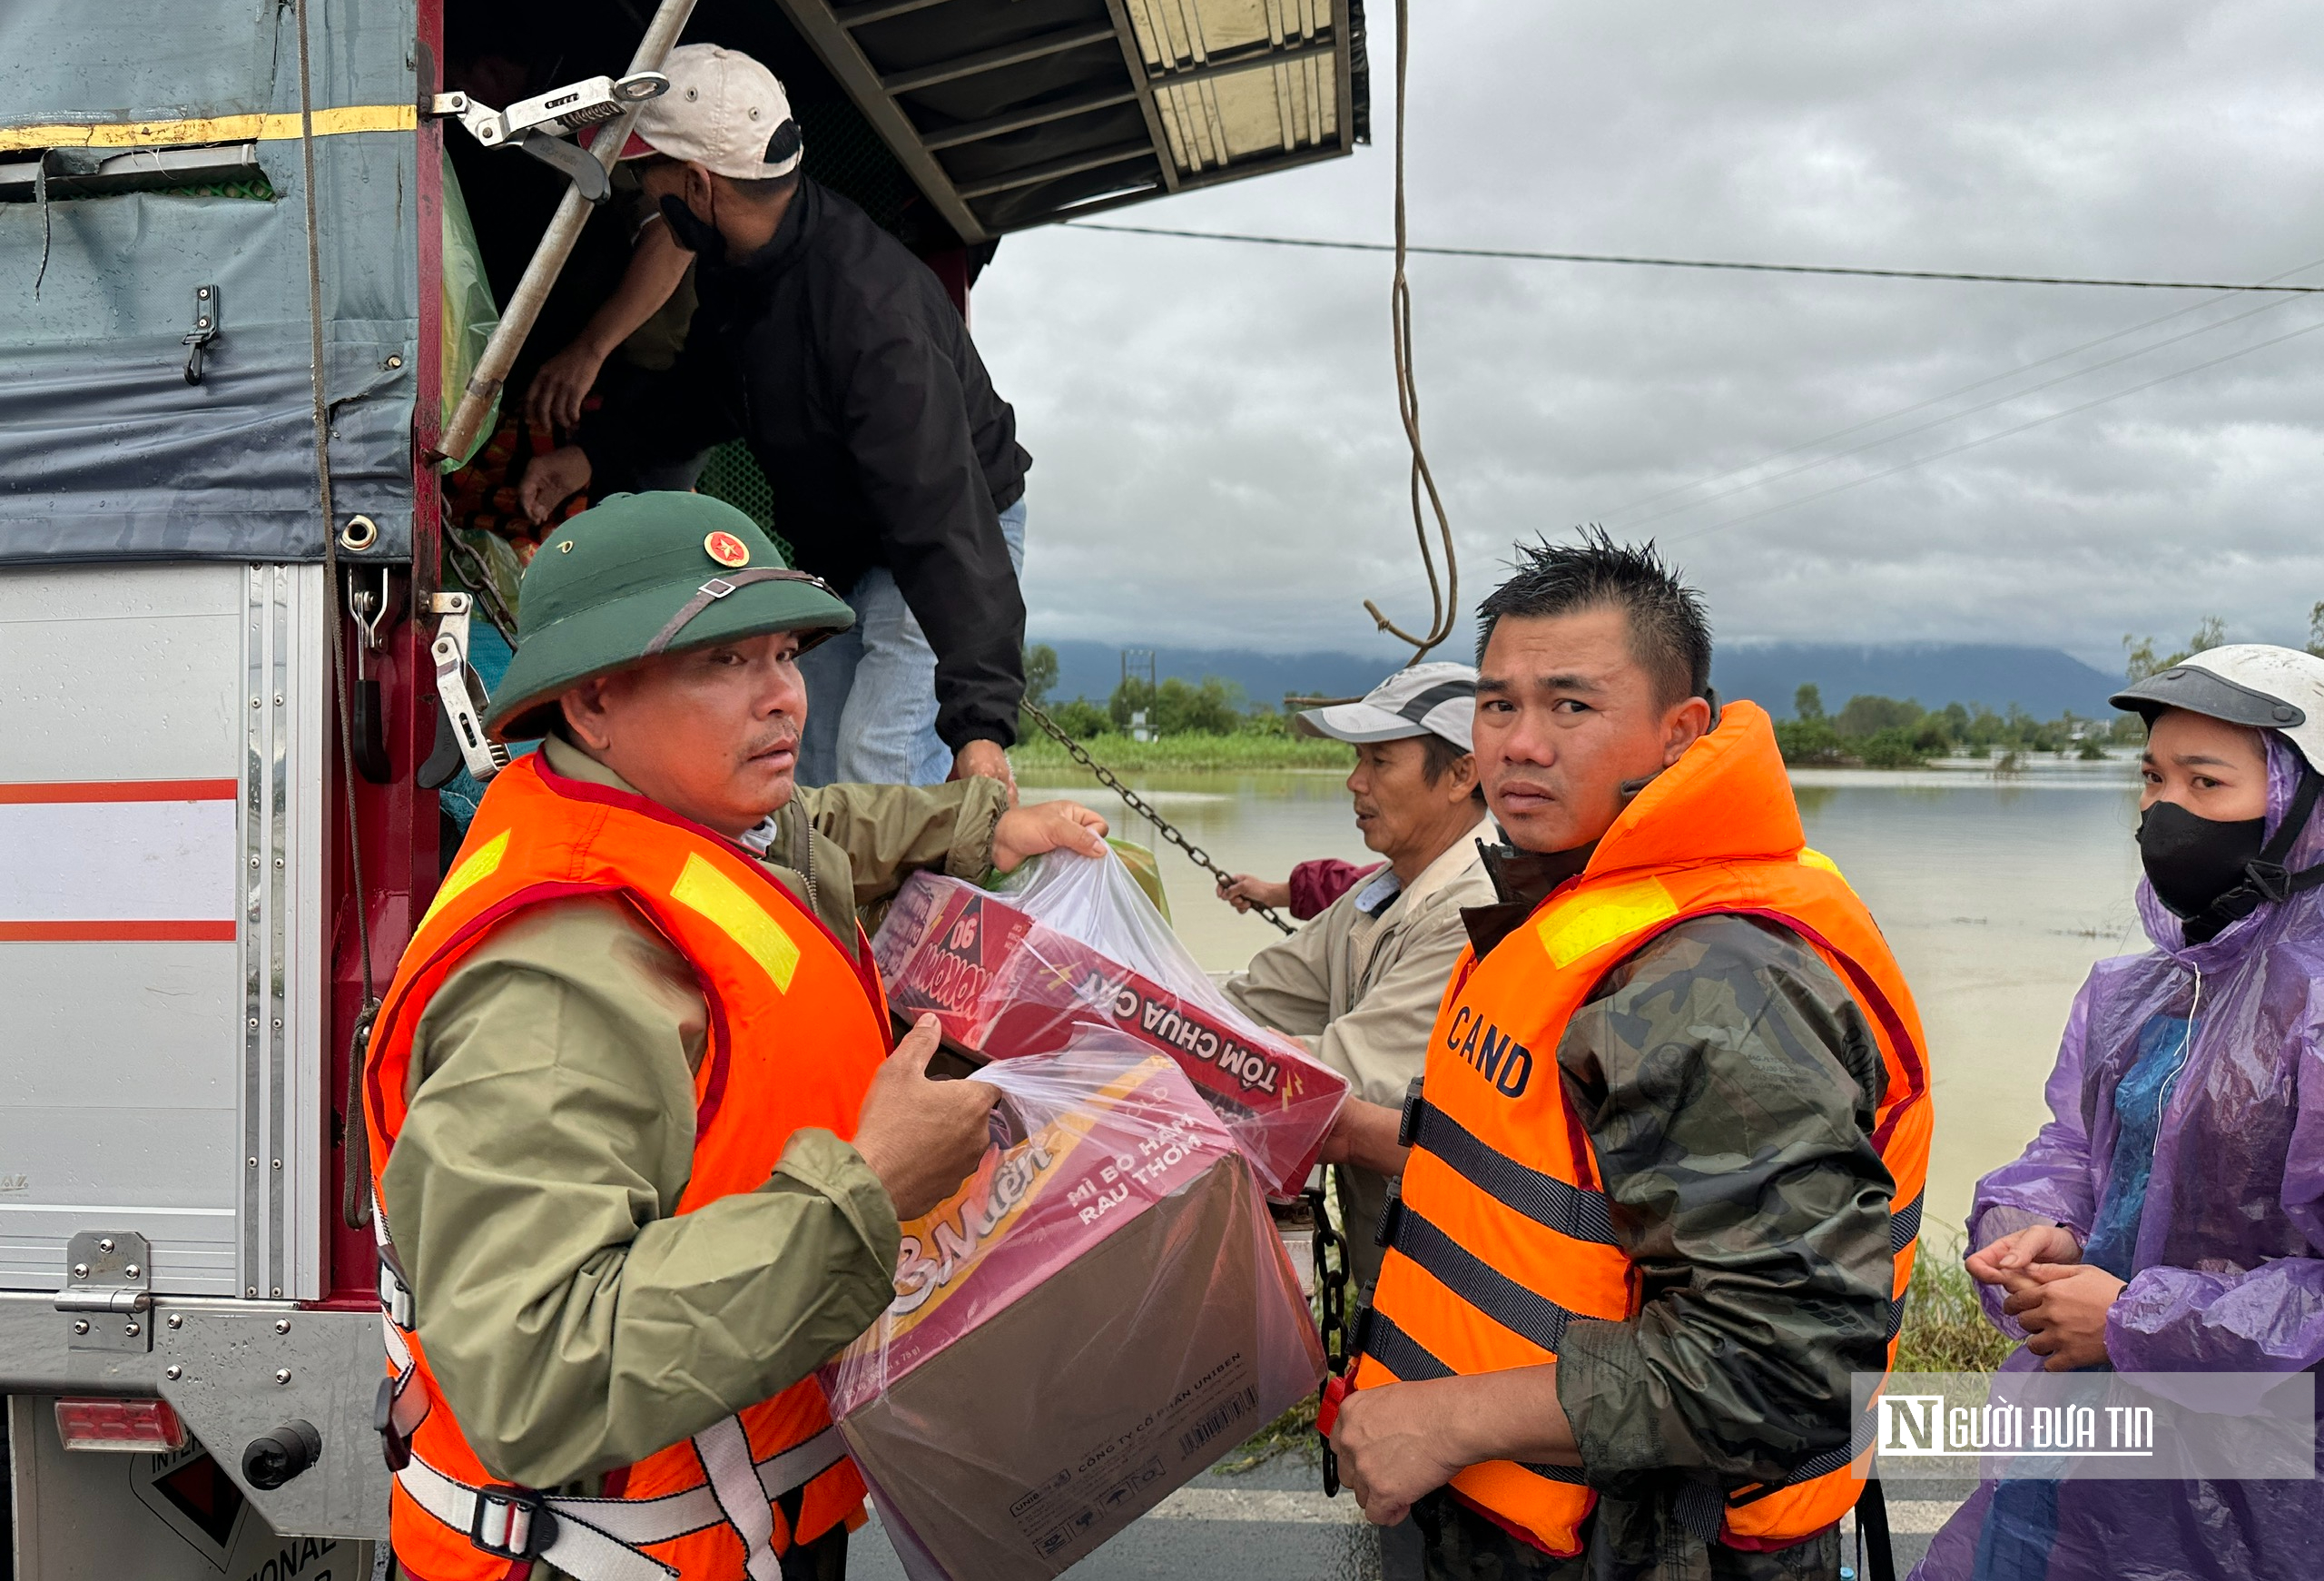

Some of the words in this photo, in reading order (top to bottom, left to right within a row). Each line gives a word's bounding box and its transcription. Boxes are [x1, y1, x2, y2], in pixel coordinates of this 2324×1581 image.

[950, 913, 979, 950] 90
[1142, 1001, 1218, 1059] CHUA
[1447, 1006, 1533, 1099] CAND
[1218, 1042, 1278, 1093] TÔM
[1067, 1177, 1098, 1208] MÌ
[1078, 1182, 1129, 1226] RAU
[1078, 1444, 1116, 1474] CÔNG
[1118, 1431, 1135, 1445] TY
[1194, 1352, 1242, 1390] UNIBEN
